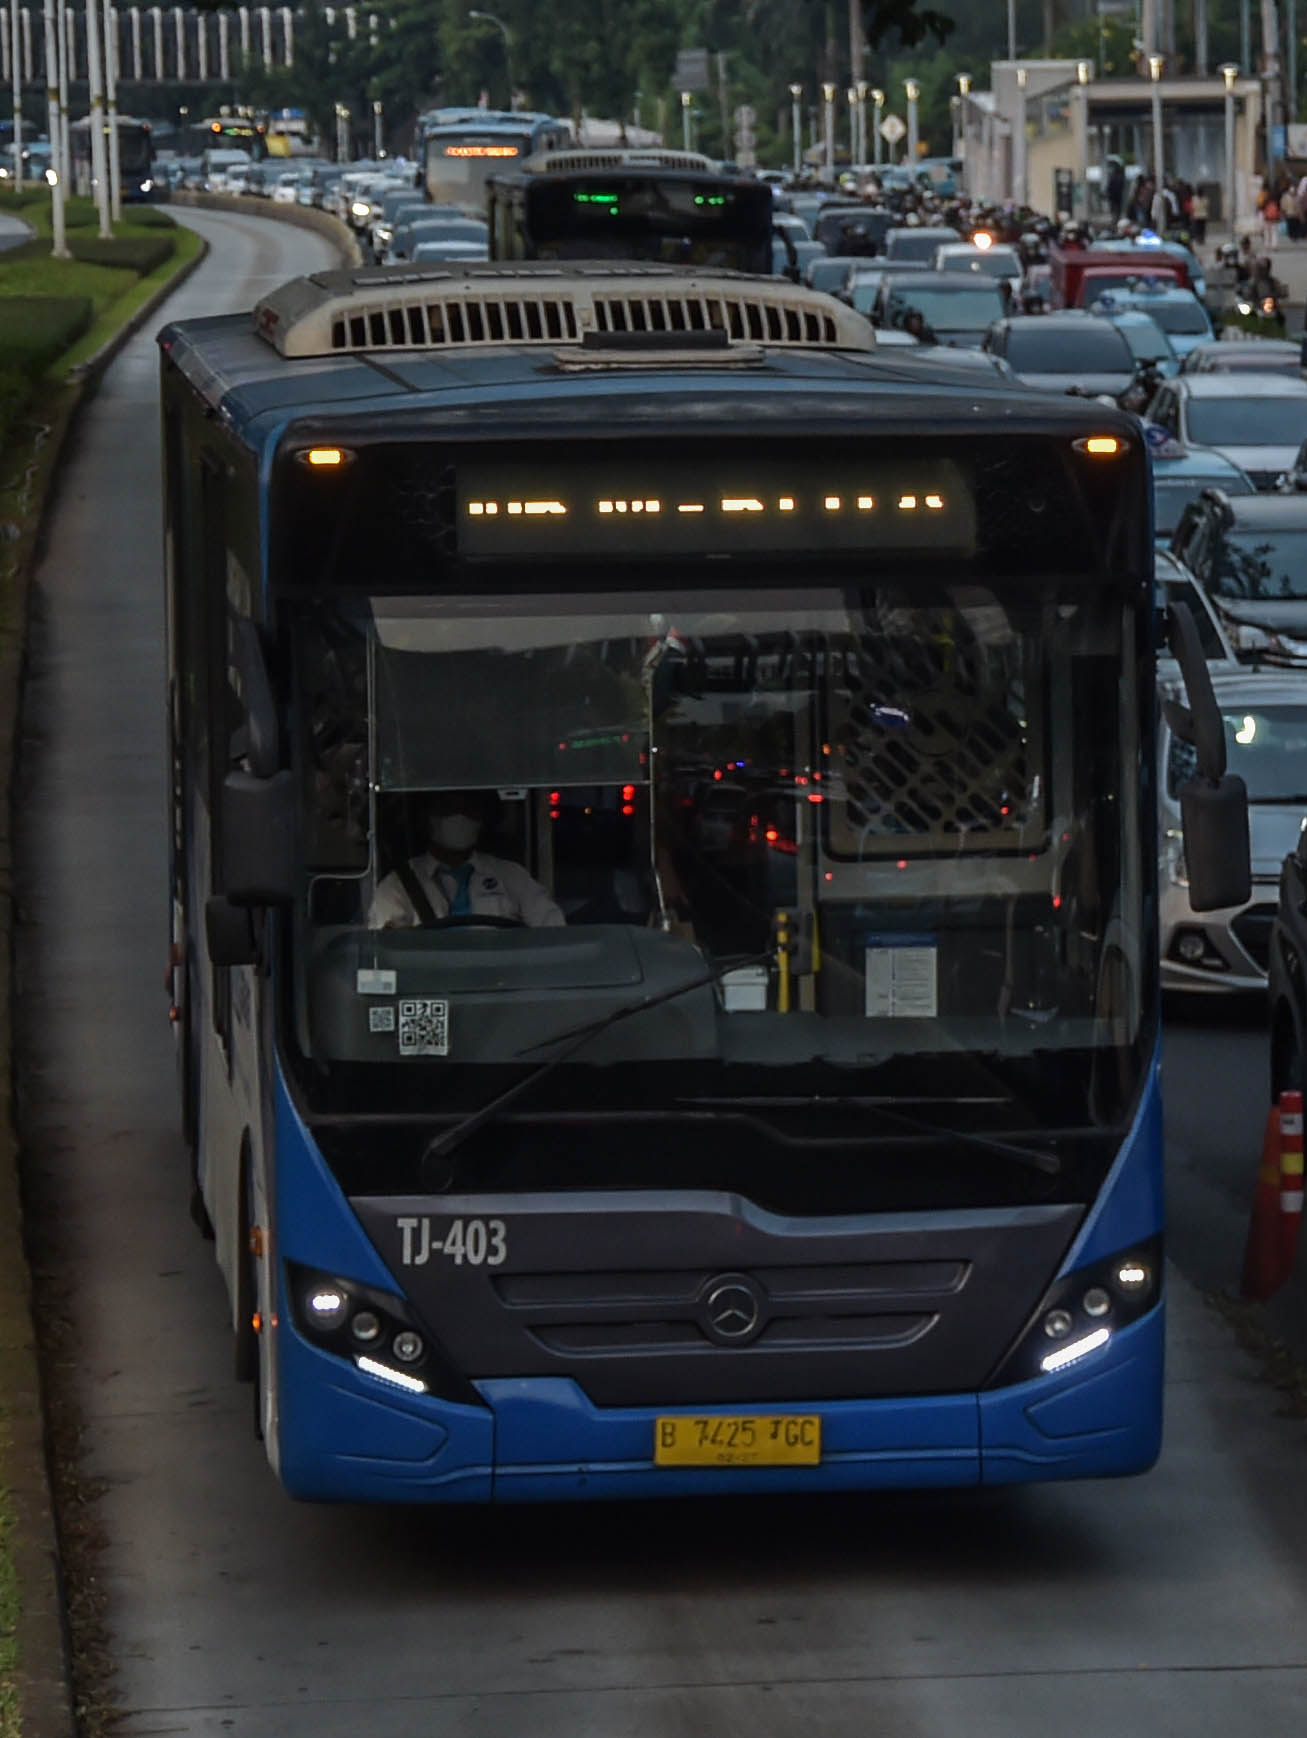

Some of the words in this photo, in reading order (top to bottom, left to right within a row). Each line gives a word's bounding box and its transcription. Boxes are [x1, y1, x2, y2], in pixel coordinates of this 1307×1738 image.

[397, 1217, 507, 1265] TJ-403
[660, 1421, 677, 1448] B
[693, 1419, 757, 1448] 7425
